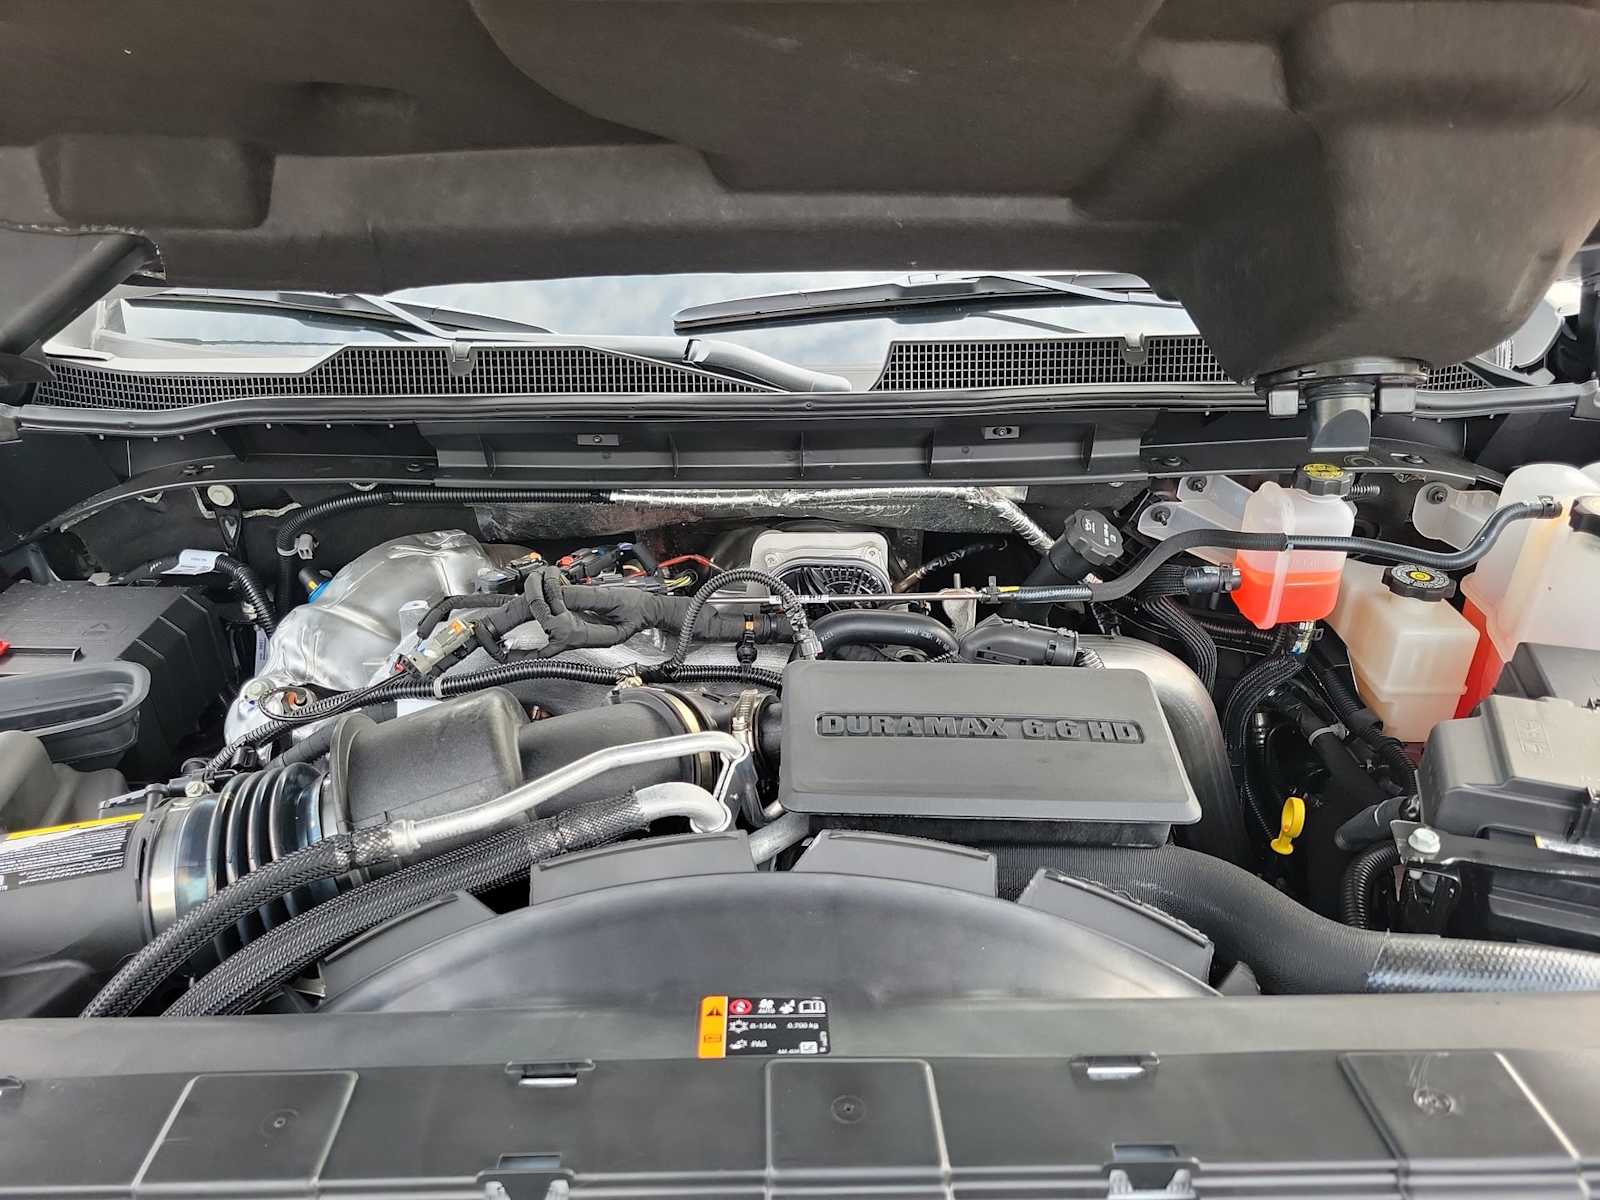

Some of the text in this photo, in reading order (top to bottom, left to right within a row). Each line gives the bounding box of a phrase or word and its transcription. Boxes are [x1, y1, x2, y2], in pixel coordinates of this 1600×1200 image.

[821, 715, 1140, 744] DURAMAX 6.6 HD
[750, 1040, 768, 1048] PAG
